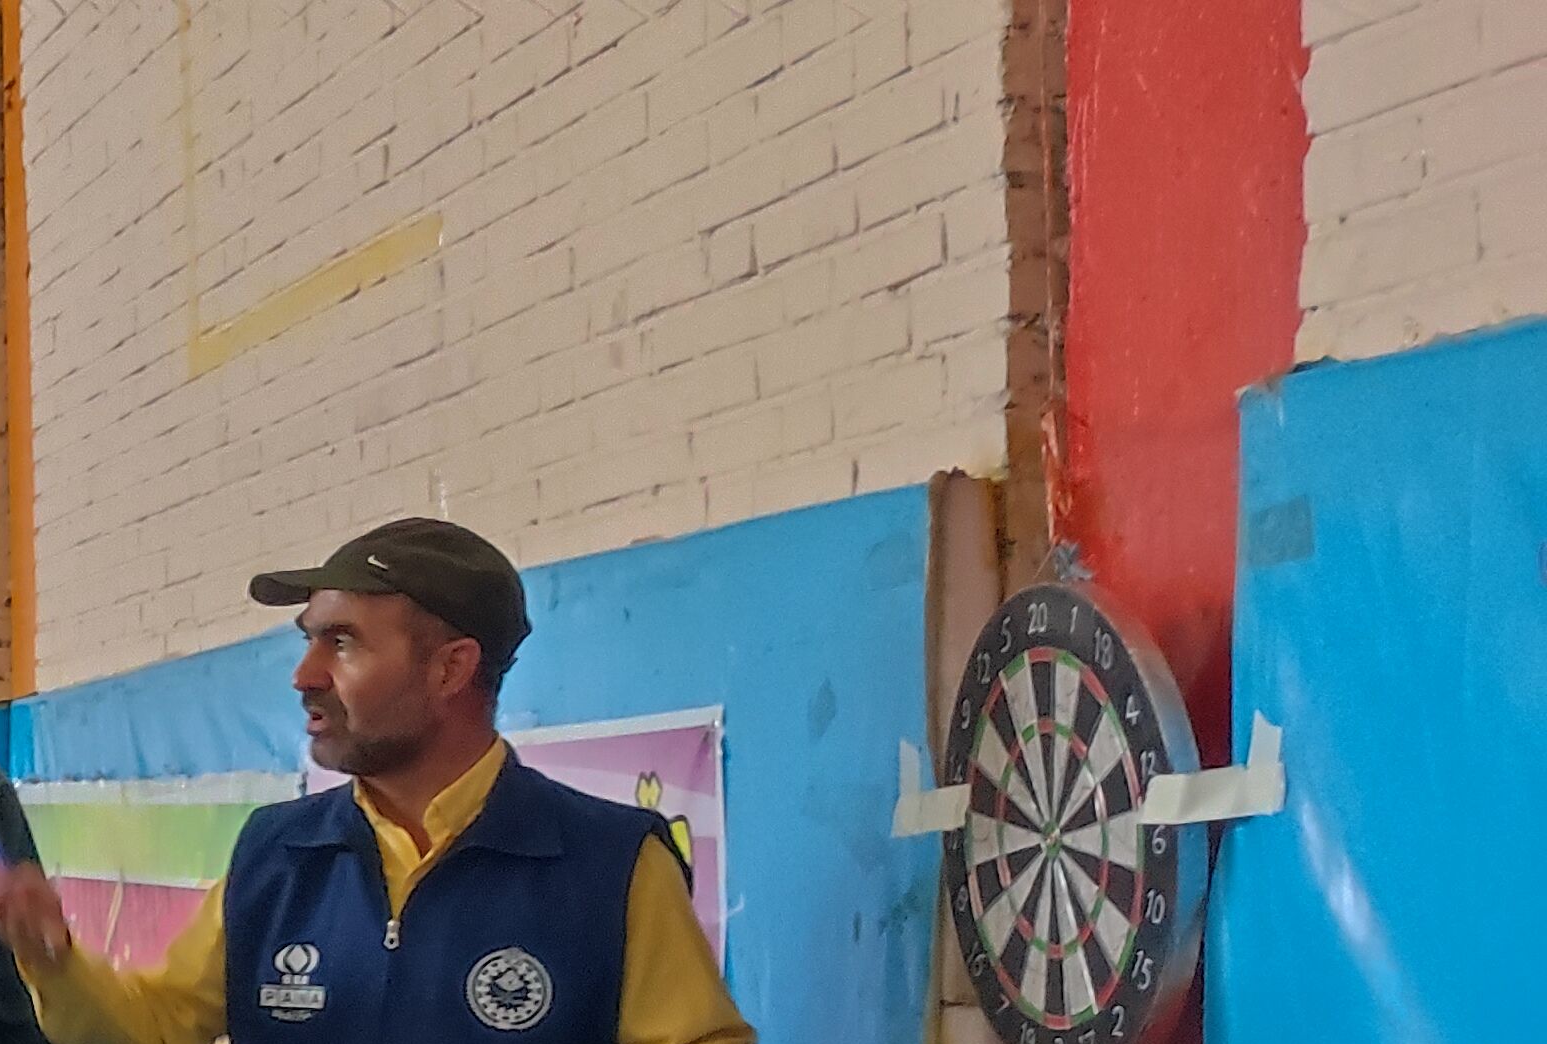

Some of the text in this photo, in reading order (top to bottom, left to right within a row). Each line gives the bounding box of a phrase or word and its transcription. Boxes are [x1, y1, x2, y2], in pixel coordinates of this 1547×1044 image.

[1000, 615, 1012, 653] 5
[1027, 602, 1048, 636] 20
[1069, 605, 1079, 634] 1
[1094, 627, 1114, 671] 18
[961, 698, 972, 730] 9
[1124, 694, 1141, 726] 4
[1151, 823, 1167, 855] 6
[1144, 887, 1167, 925] 10
[1130, 949, 1154, 991] 15
[1110, 1004, 1126, 1038] 2
